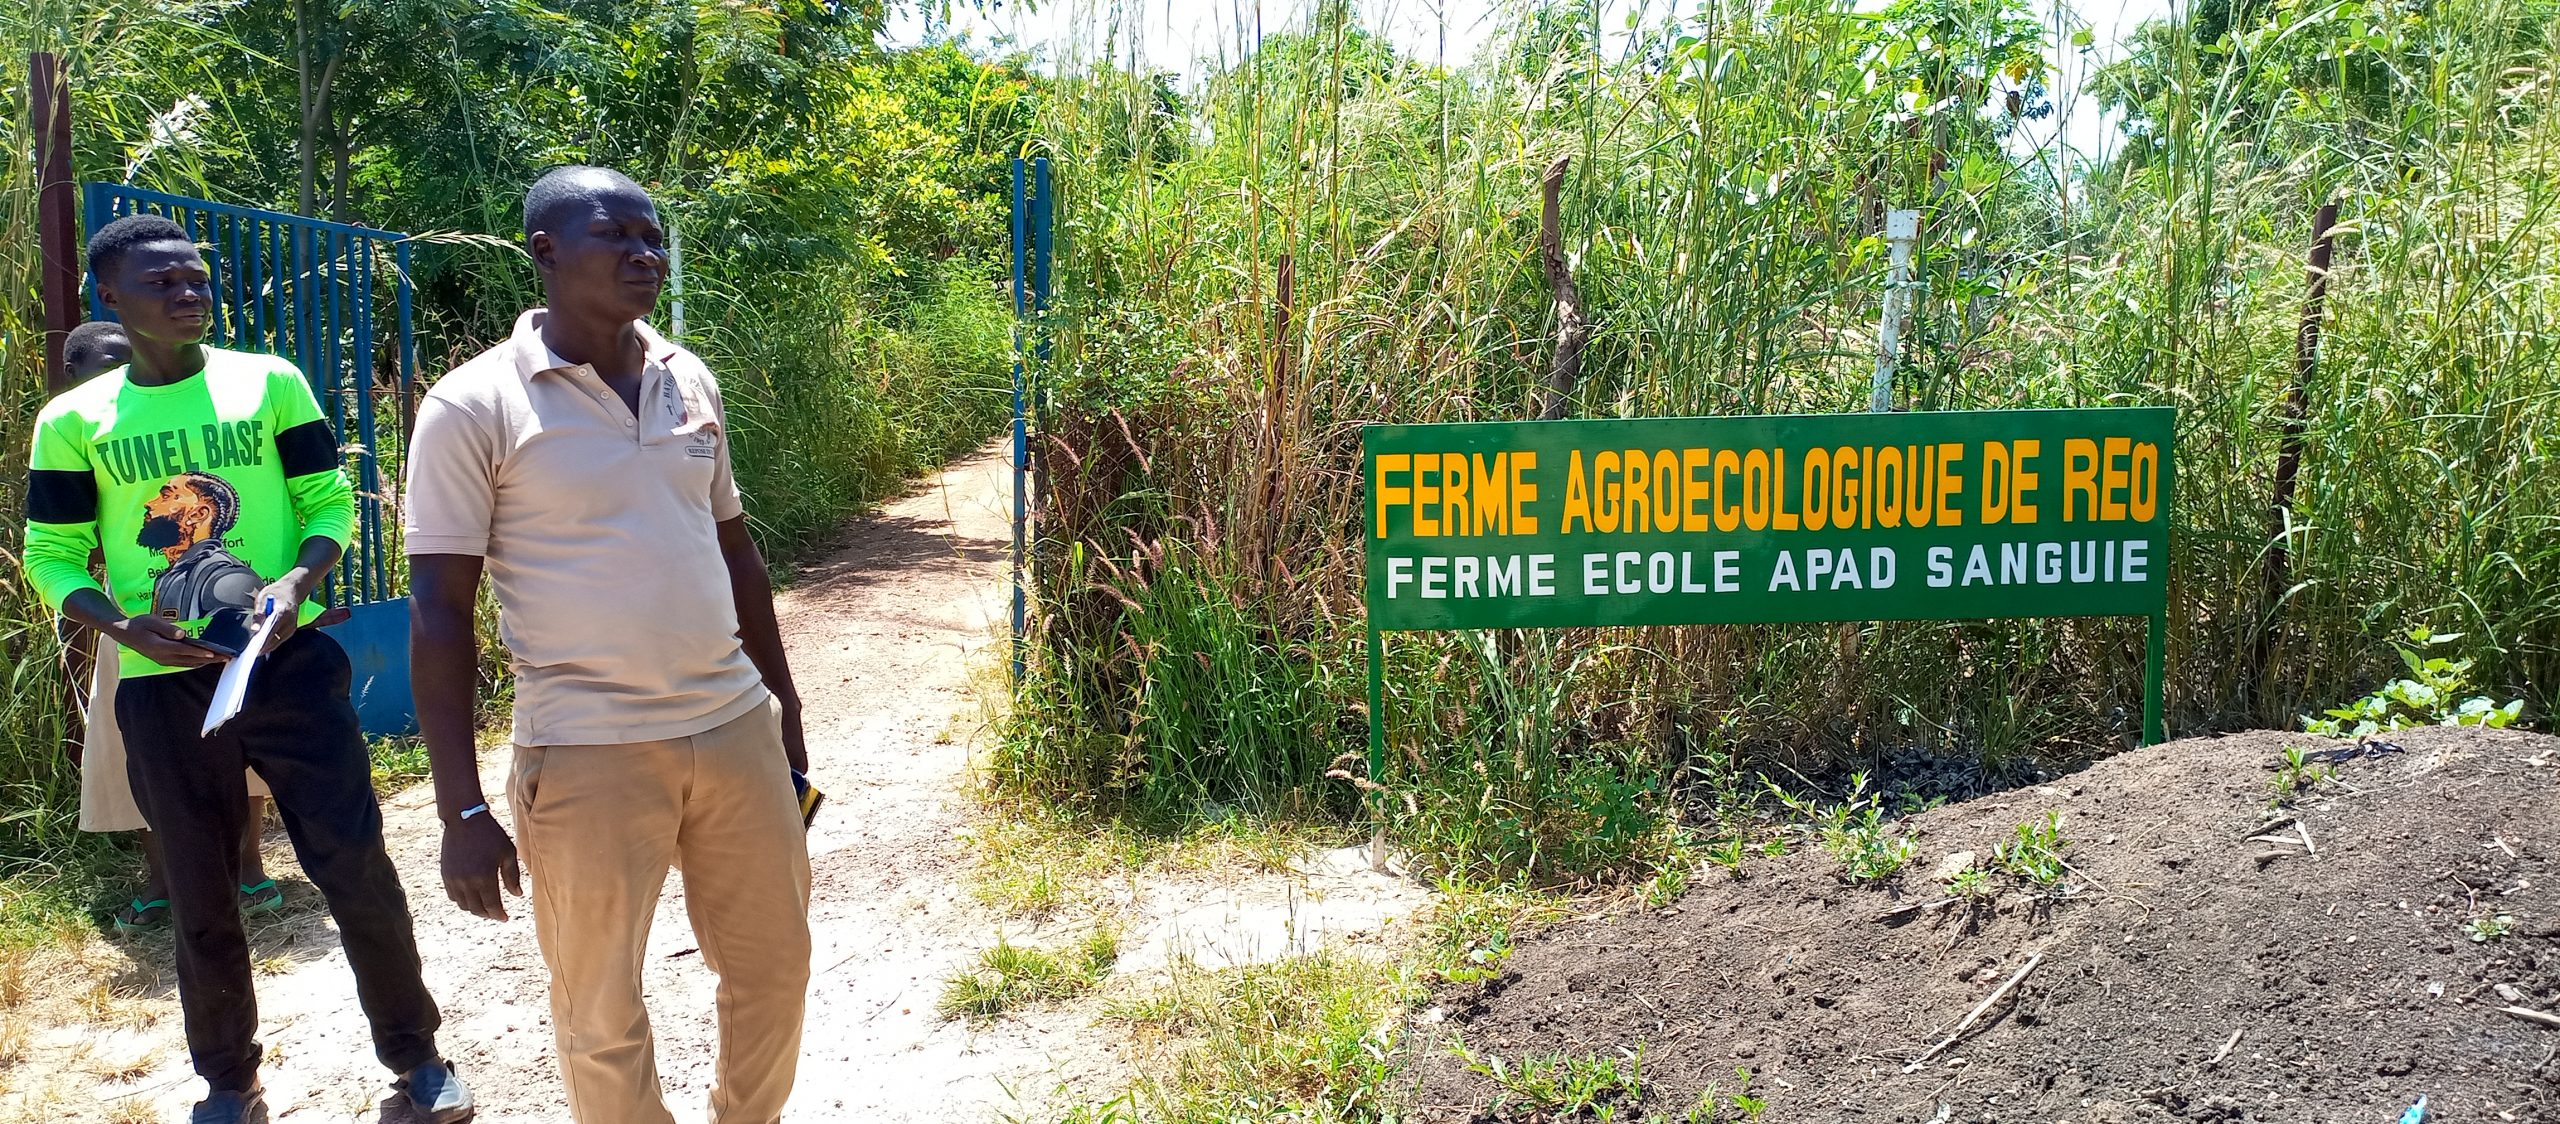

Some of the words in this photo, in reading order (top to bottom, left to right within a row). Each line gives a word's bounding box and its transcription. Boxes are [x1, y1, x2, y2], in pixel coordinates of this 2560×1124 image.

[95, 428, 200, 486] TUNEL
[202, 420, 263, 469] BASE
[1376, 451, 1538, 539] FERME
[1561, 443, 1964, 534] AGROECOLOGIQUE
[1981, 439, 2040, 524] DE
[2063, 437, 2159, 522] REO
[1387, 554, 1556, 599] FERME
[1583, 550, 1740, 595] ECOLE
[1767, 546, 1897, 592] APAD
[1926, 540, 2148, 588] SANGUIE
